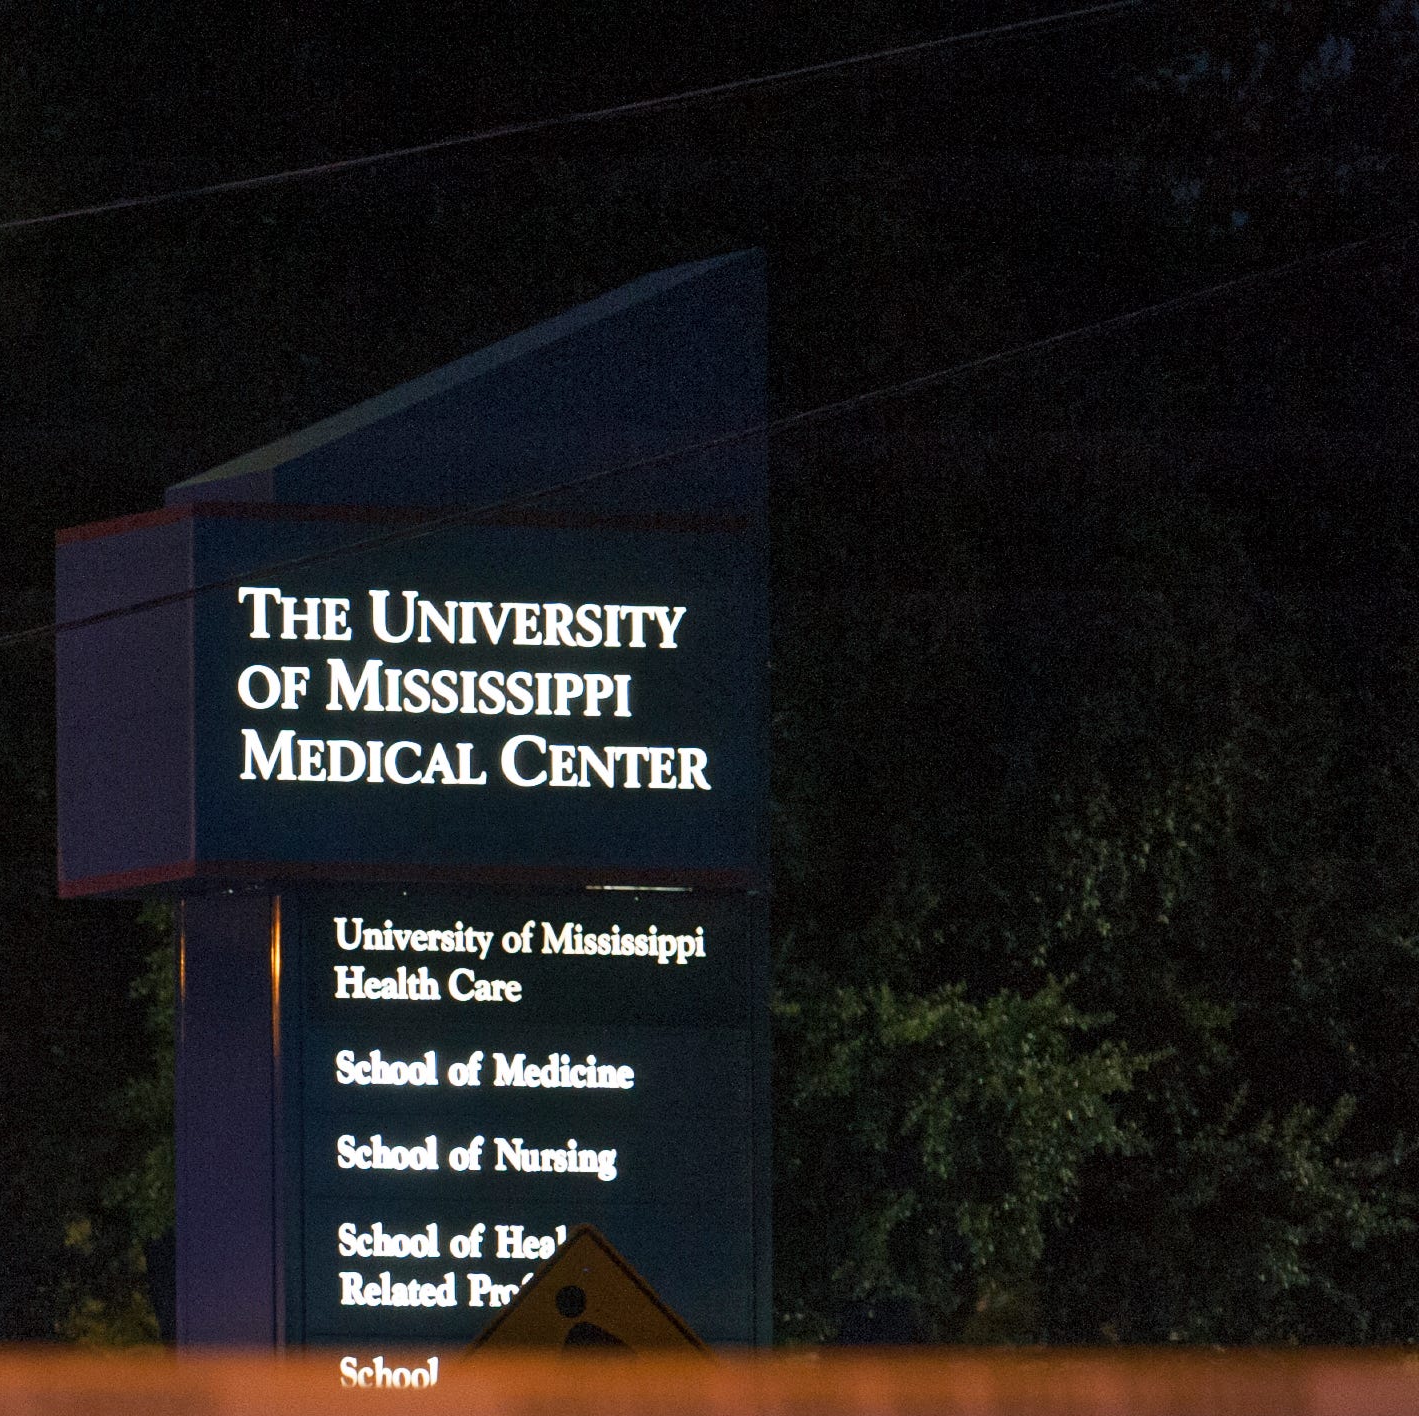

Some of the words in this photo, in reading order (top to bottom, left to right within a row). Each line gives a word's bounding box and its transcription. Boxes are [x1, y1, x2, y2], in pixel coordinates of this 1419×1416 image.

[238, 587, 352, 641] THE
[369, 590, 686, 648] UNIVERSITY
[238, 665, 310, 709] OF
[326, 658, 631, 717] MISSISSIPPI
[240, 729, 487, 785] MEDICAL
[501, 735, 711, 790] CENTER
[334, 917, 494, 960] University
[502, 920, 535, 953] of
[542, 922, 706, 964] Mississippi
[334, 966, 441, 1000] Health
[448, 968, 522, 1002] Care
[336, 1049, 438, 1086] School
[448, 1051, 484, 1086] of
[493, 1053, 634, 1089] Medicine
[337, 1134, 439, 1170] School
[449, 1135, 484, 1171] of
[494, 1138, 617, 1181] Nursing
[338, 1222, 440, 1258] School
[450, 1223, 485, 1258] of
[494, 1225, 567, 1259] Heal
[339, 1271, 457, 1307] Related
[467, 1273, 534, 1307] Pro
[340, 1356, 439, 1389] School
